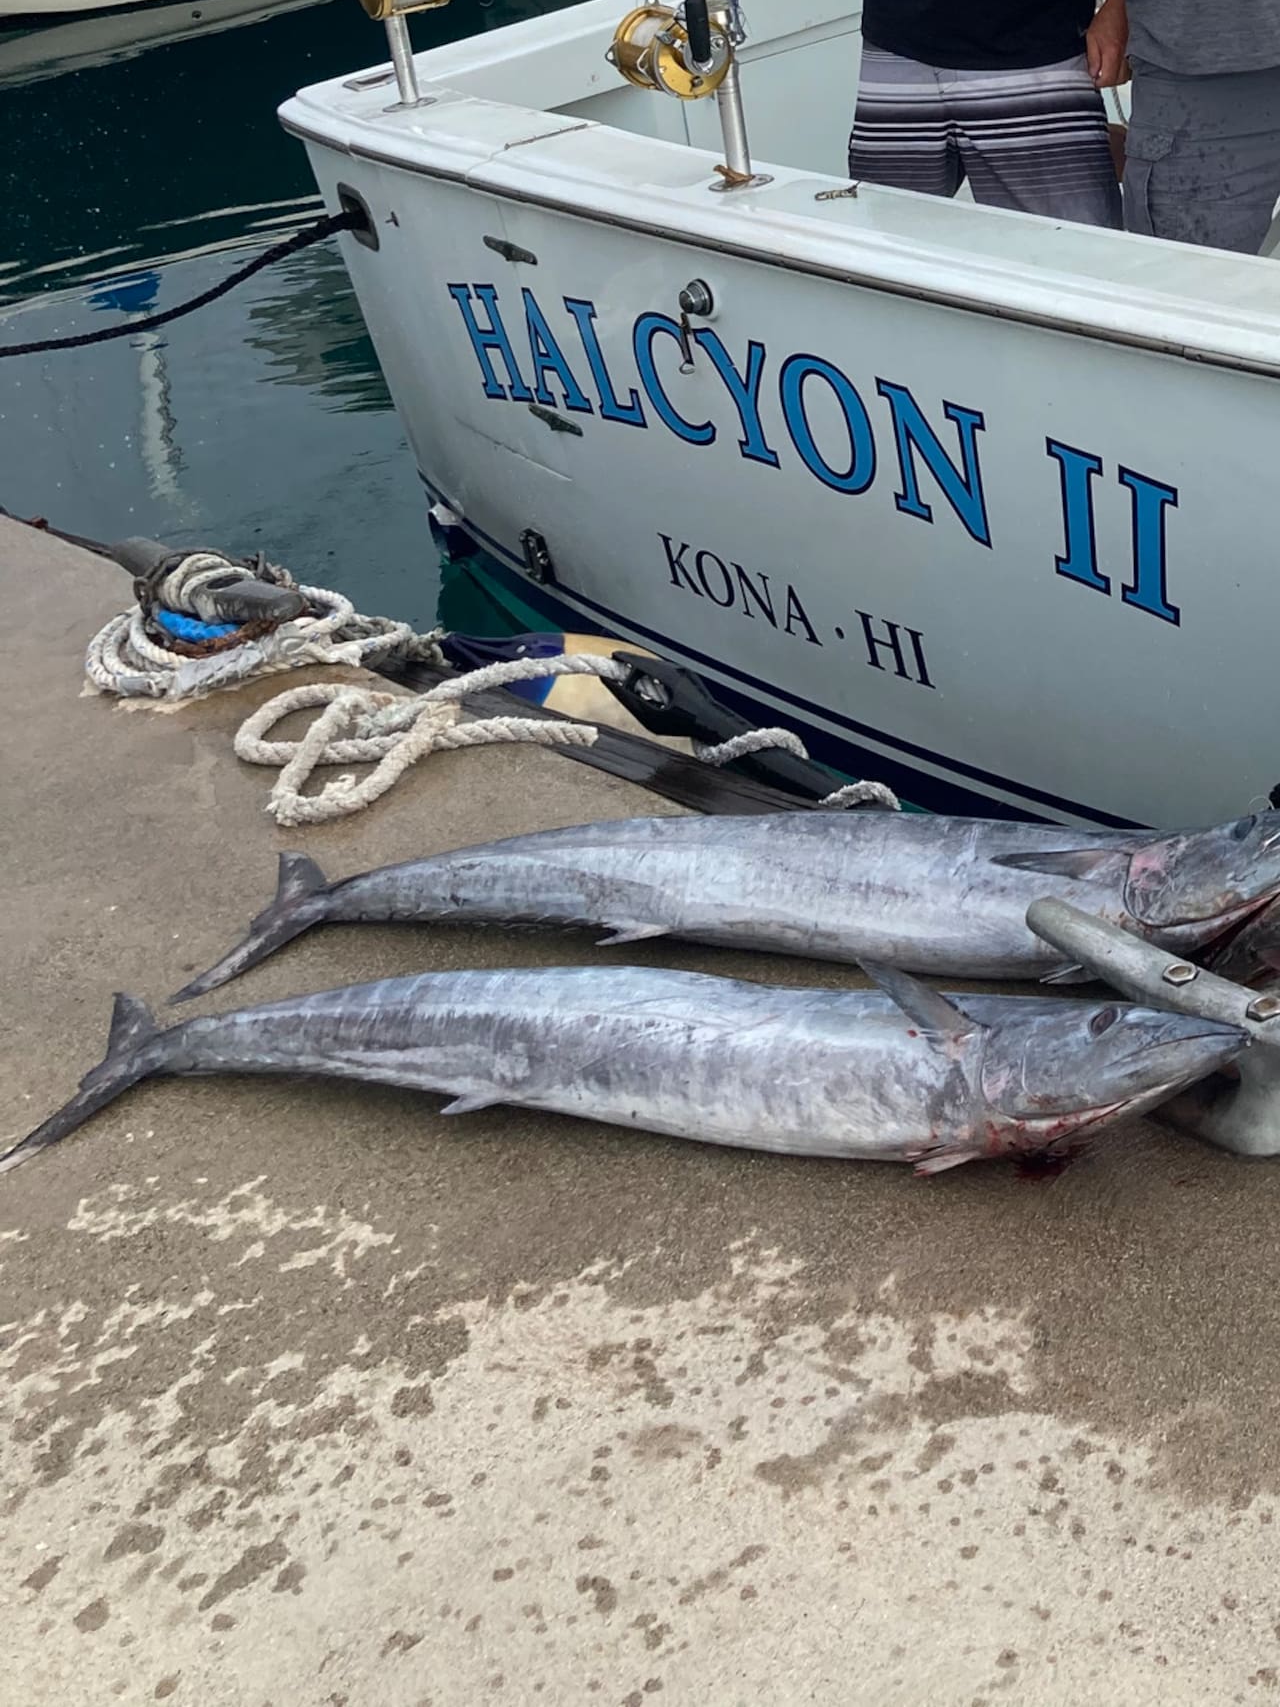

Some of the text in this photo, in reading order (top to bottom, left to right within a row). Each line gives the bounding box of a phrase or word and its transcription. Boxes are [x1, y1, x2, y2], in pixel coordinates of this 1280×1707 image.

[448, 283, 1180, 626] HALCYON II
[657, 532, 936, 689] KONA HI
